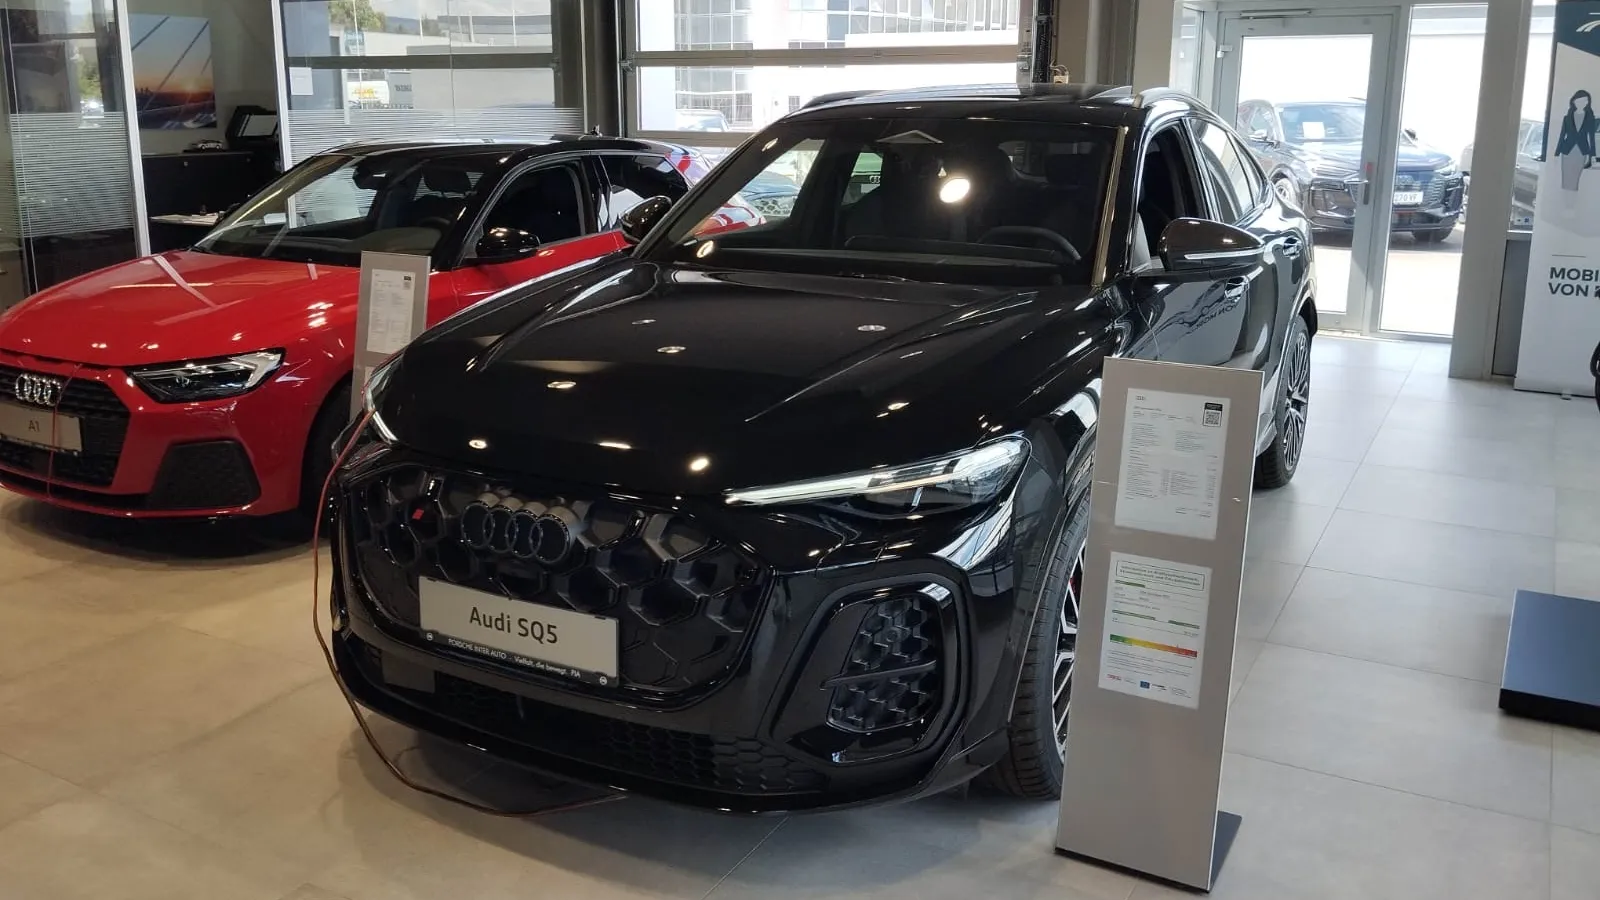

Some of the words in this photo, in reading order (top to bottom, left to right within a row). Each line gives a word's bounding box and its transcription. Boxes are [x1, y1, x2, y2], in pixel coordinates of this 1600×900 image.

[1550, 267, 1600, 282] MOBI
[1548, 282, 1589, 297] VON
[28, 420, 40, 432] A1
[469, 606, 511, 633] Audi
[517, 618, 558, 644] SQ5
[448, 638, 473, 651] PORSCHE
[474, 646, 490, 655] INTER
[490, 650, 507, 660] AUTO
[570, 669, 581, 678] PIA
